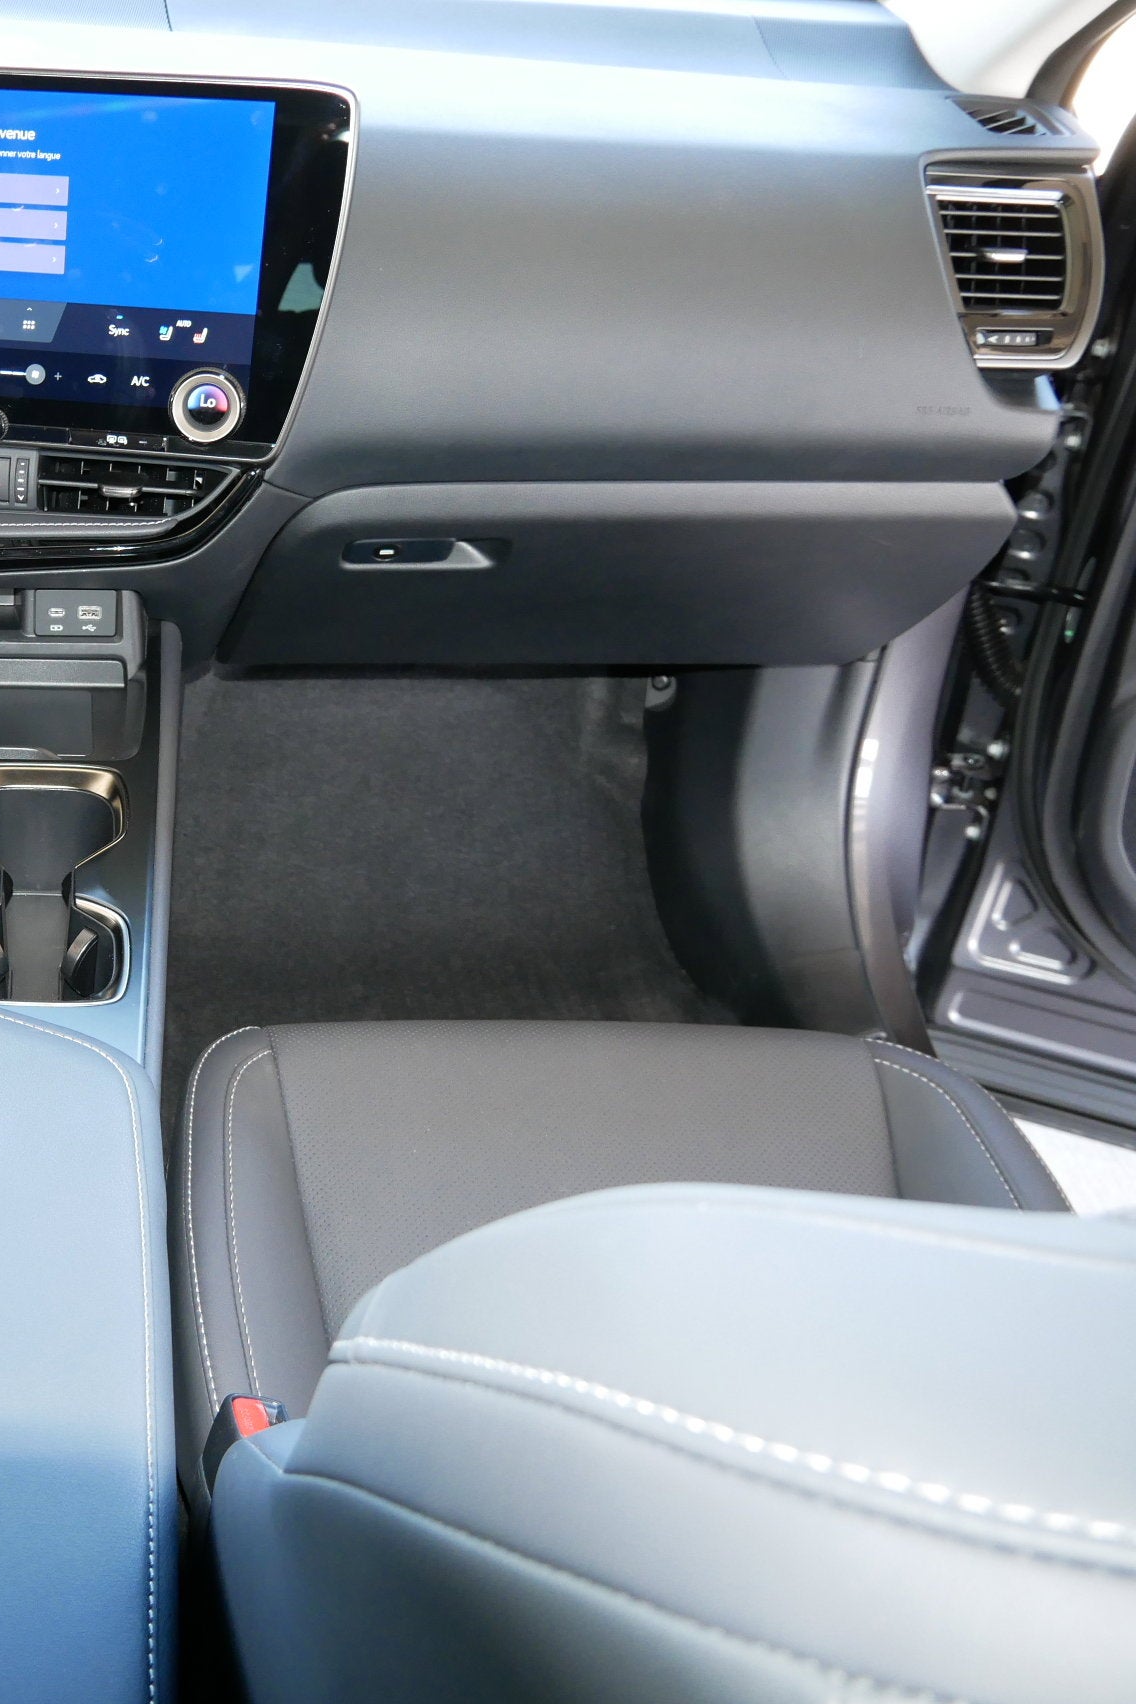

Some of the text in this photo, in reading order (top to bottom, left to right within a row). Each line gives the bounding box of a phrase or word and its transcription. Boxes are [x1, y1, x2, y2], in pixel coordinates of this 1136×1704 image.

[18, 151, 36, 159] votre
[37, 150, 62, 161] langue
[176, 319, 192, 328] AUTO
[108, 324, 130, 337] Sync
[130, 375, 151, 388] A/C
[200, 393, 217, 409] Lo
